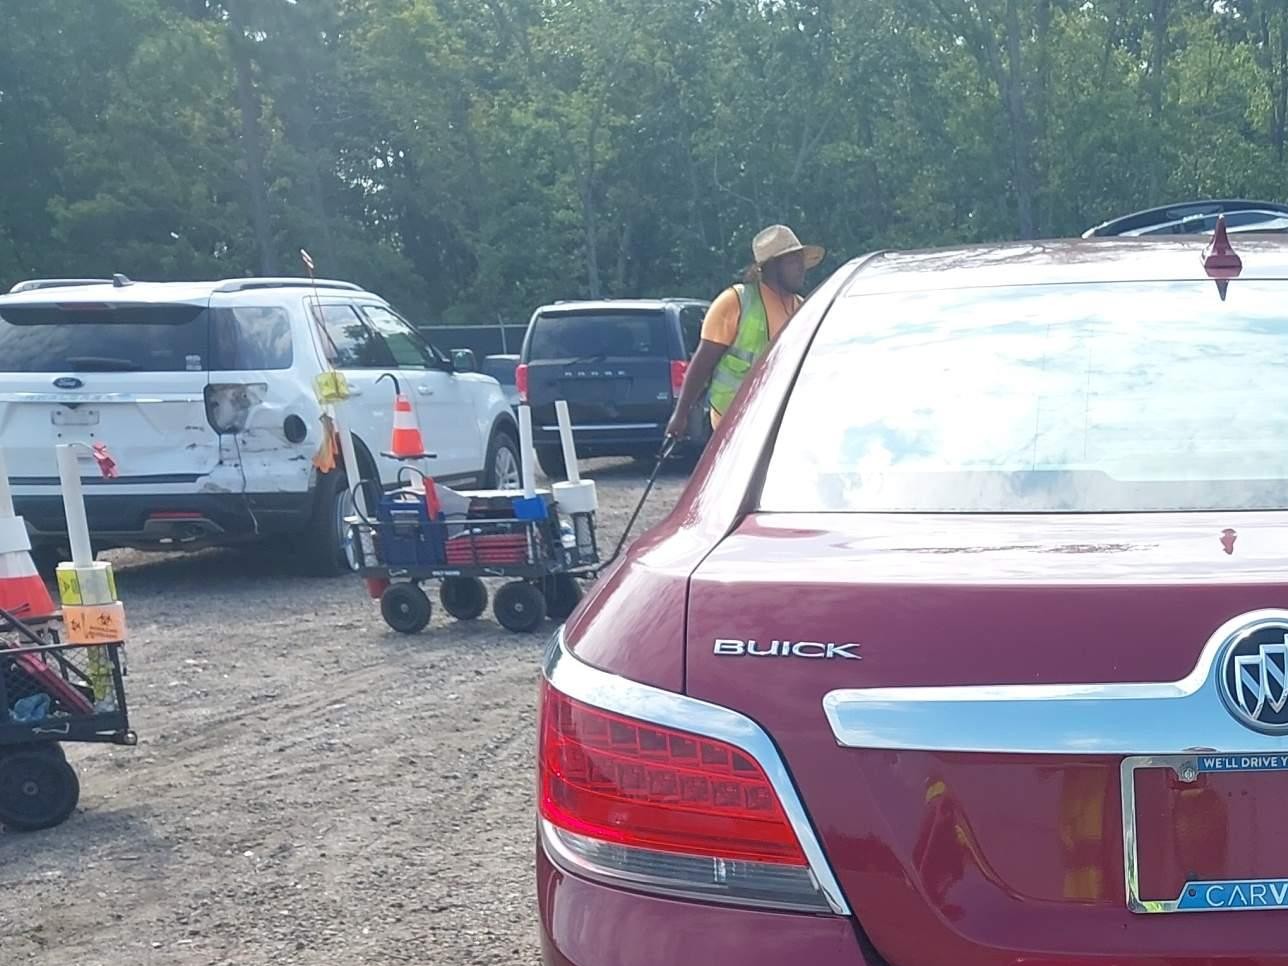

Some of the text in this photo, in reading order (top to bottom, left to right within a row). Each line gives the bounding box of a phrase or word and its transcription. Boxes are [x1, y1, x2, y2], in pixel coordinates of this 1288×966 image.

[713, 639, 862, 660] BUICK
[1204, 757, 1239, 769] WE'LL
[1241, 756, 1278, 768] DRIVE
